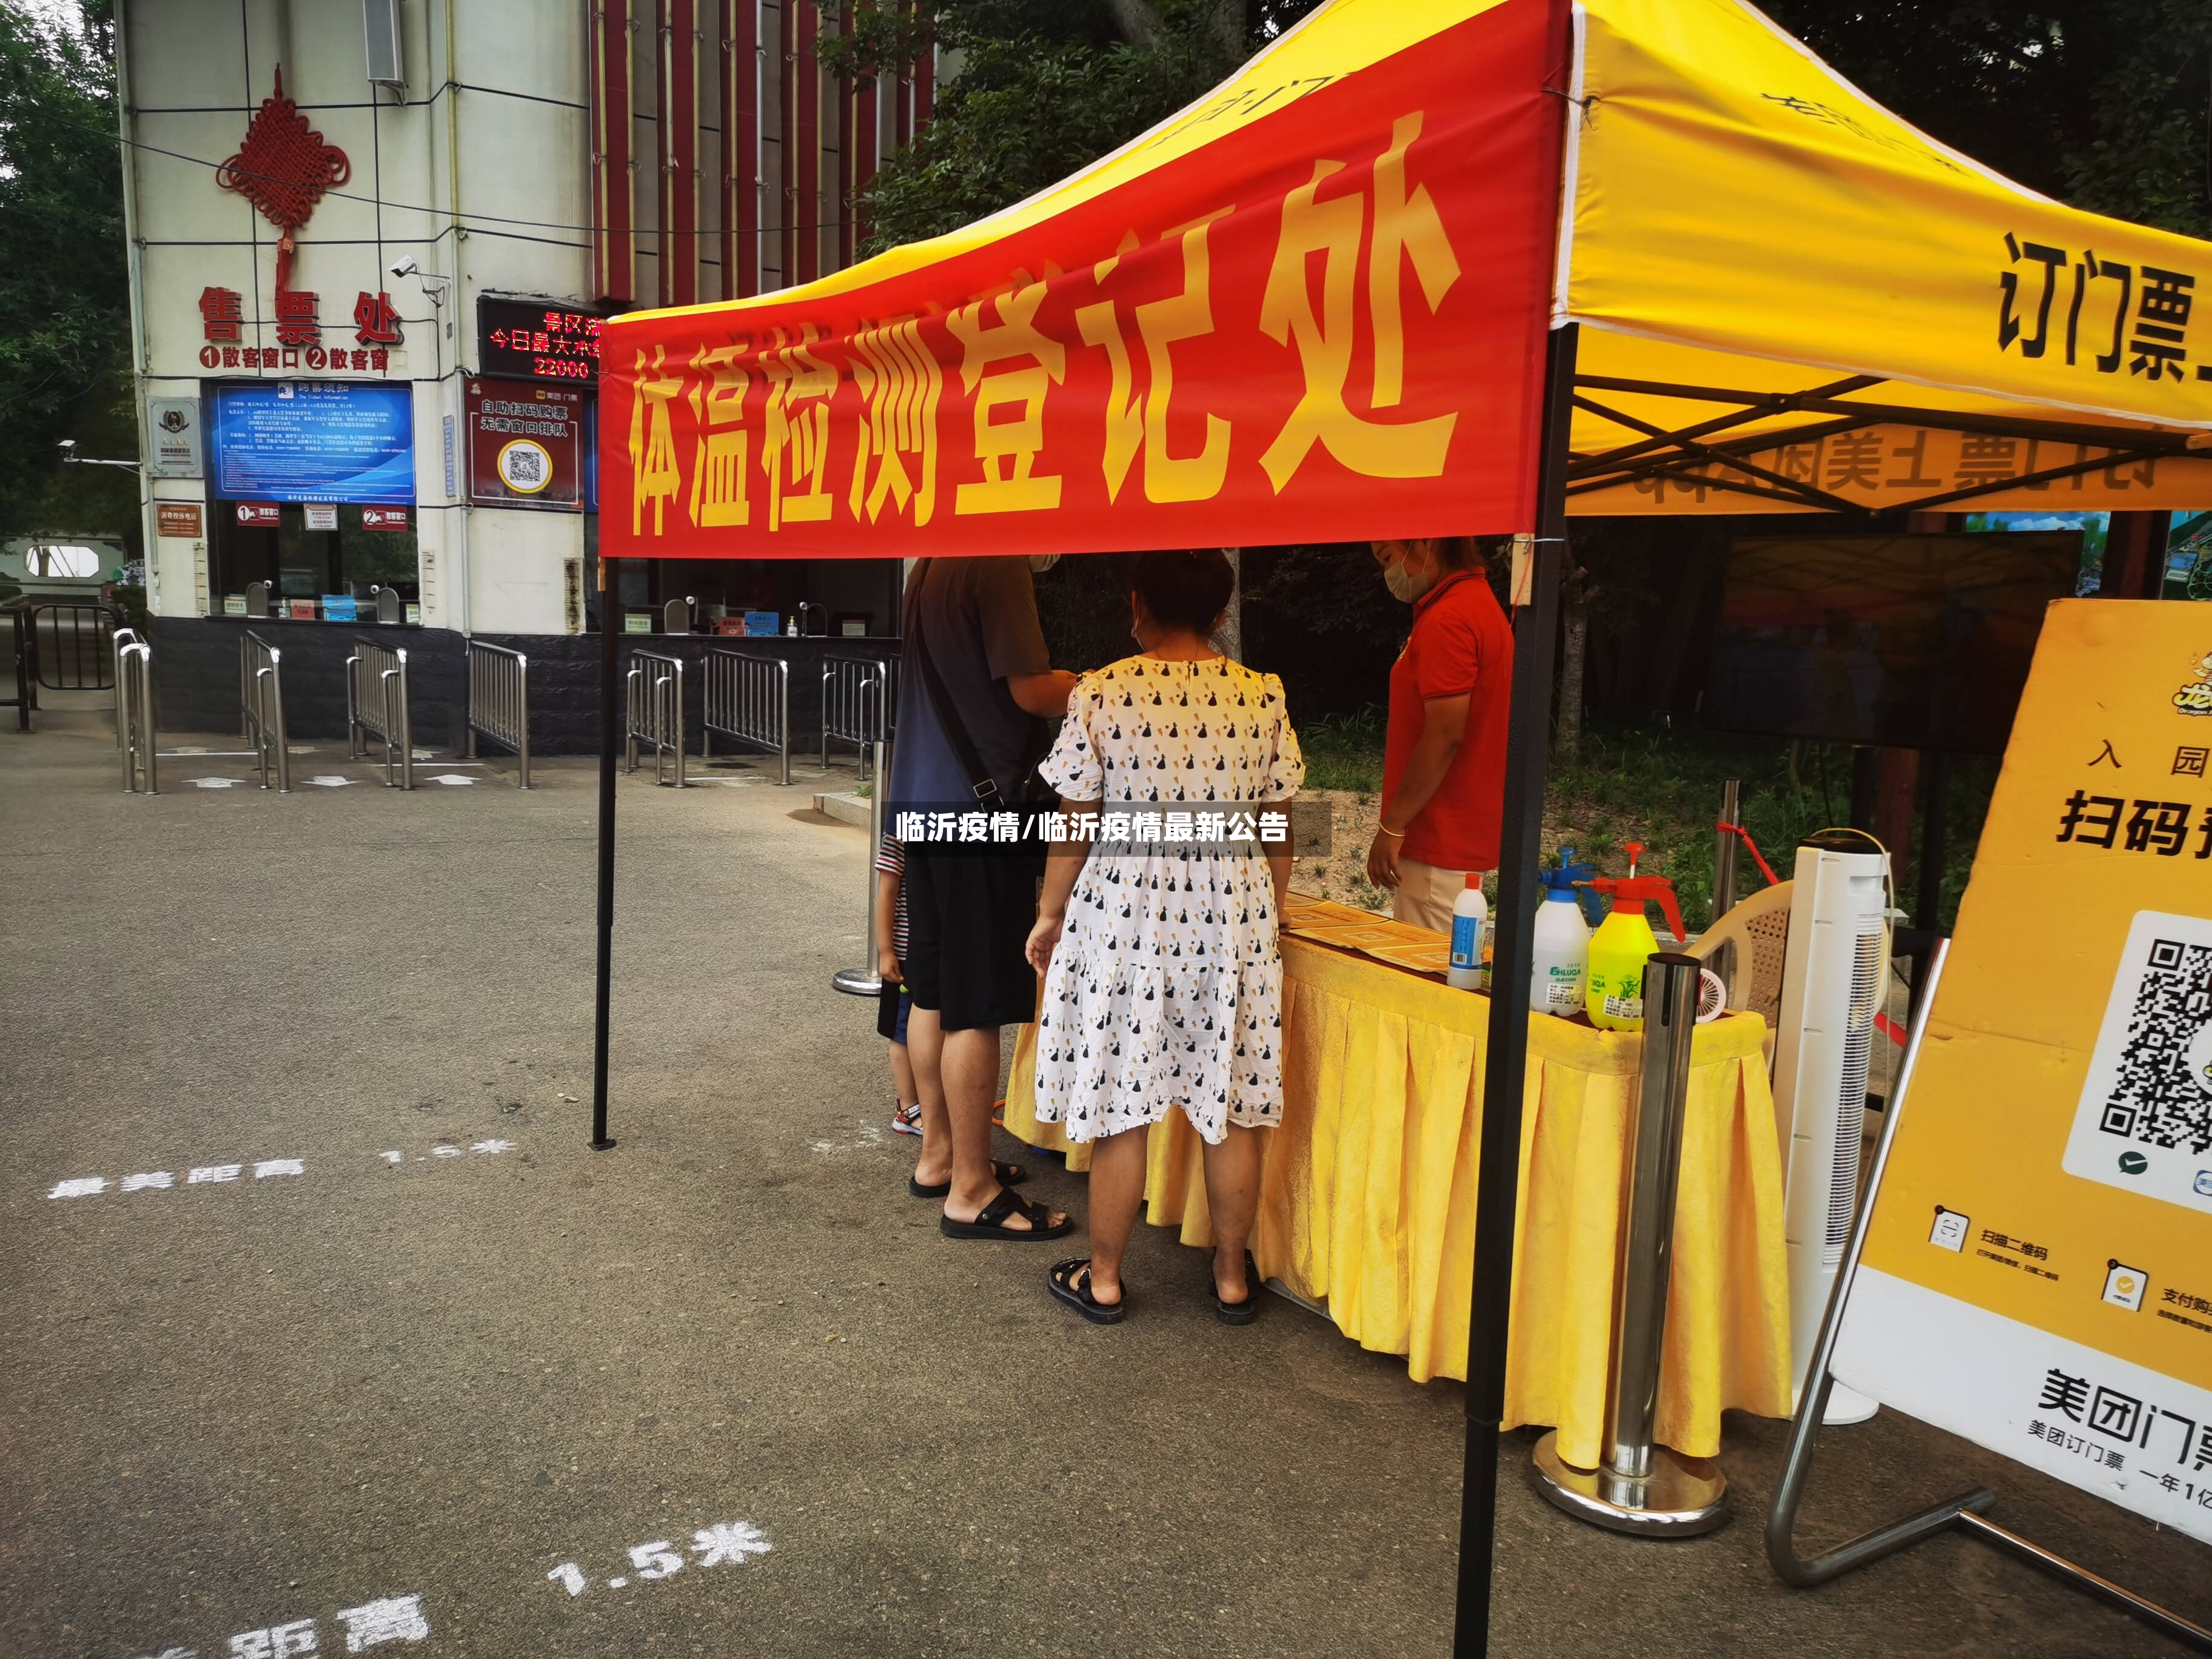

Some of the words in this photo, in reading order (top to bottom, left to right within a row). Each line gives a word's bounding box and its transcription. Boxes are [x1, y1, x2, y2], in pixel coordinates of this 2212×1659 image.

[199, 287, 402, 346] 售票处
[629, 110, 1461, 536] 体温检测登记处
[1997, 232, 2212, 383] 订门票
[534, 357, 588, 379] 22000
[481, 400, 568, 420] 自助扫码购票
[481, 417, 568, 437] 无需窗口排队
[2173, 683, 2212, 709] 龙
[1980, 1229, 2048, 1261] 扫描二维码
[2160, 1289, 2212, 1316] 支付购
[2028, 1419, 2126, 1472] 美团订门票
[548, 1521, 773, 1597] 1.5米
